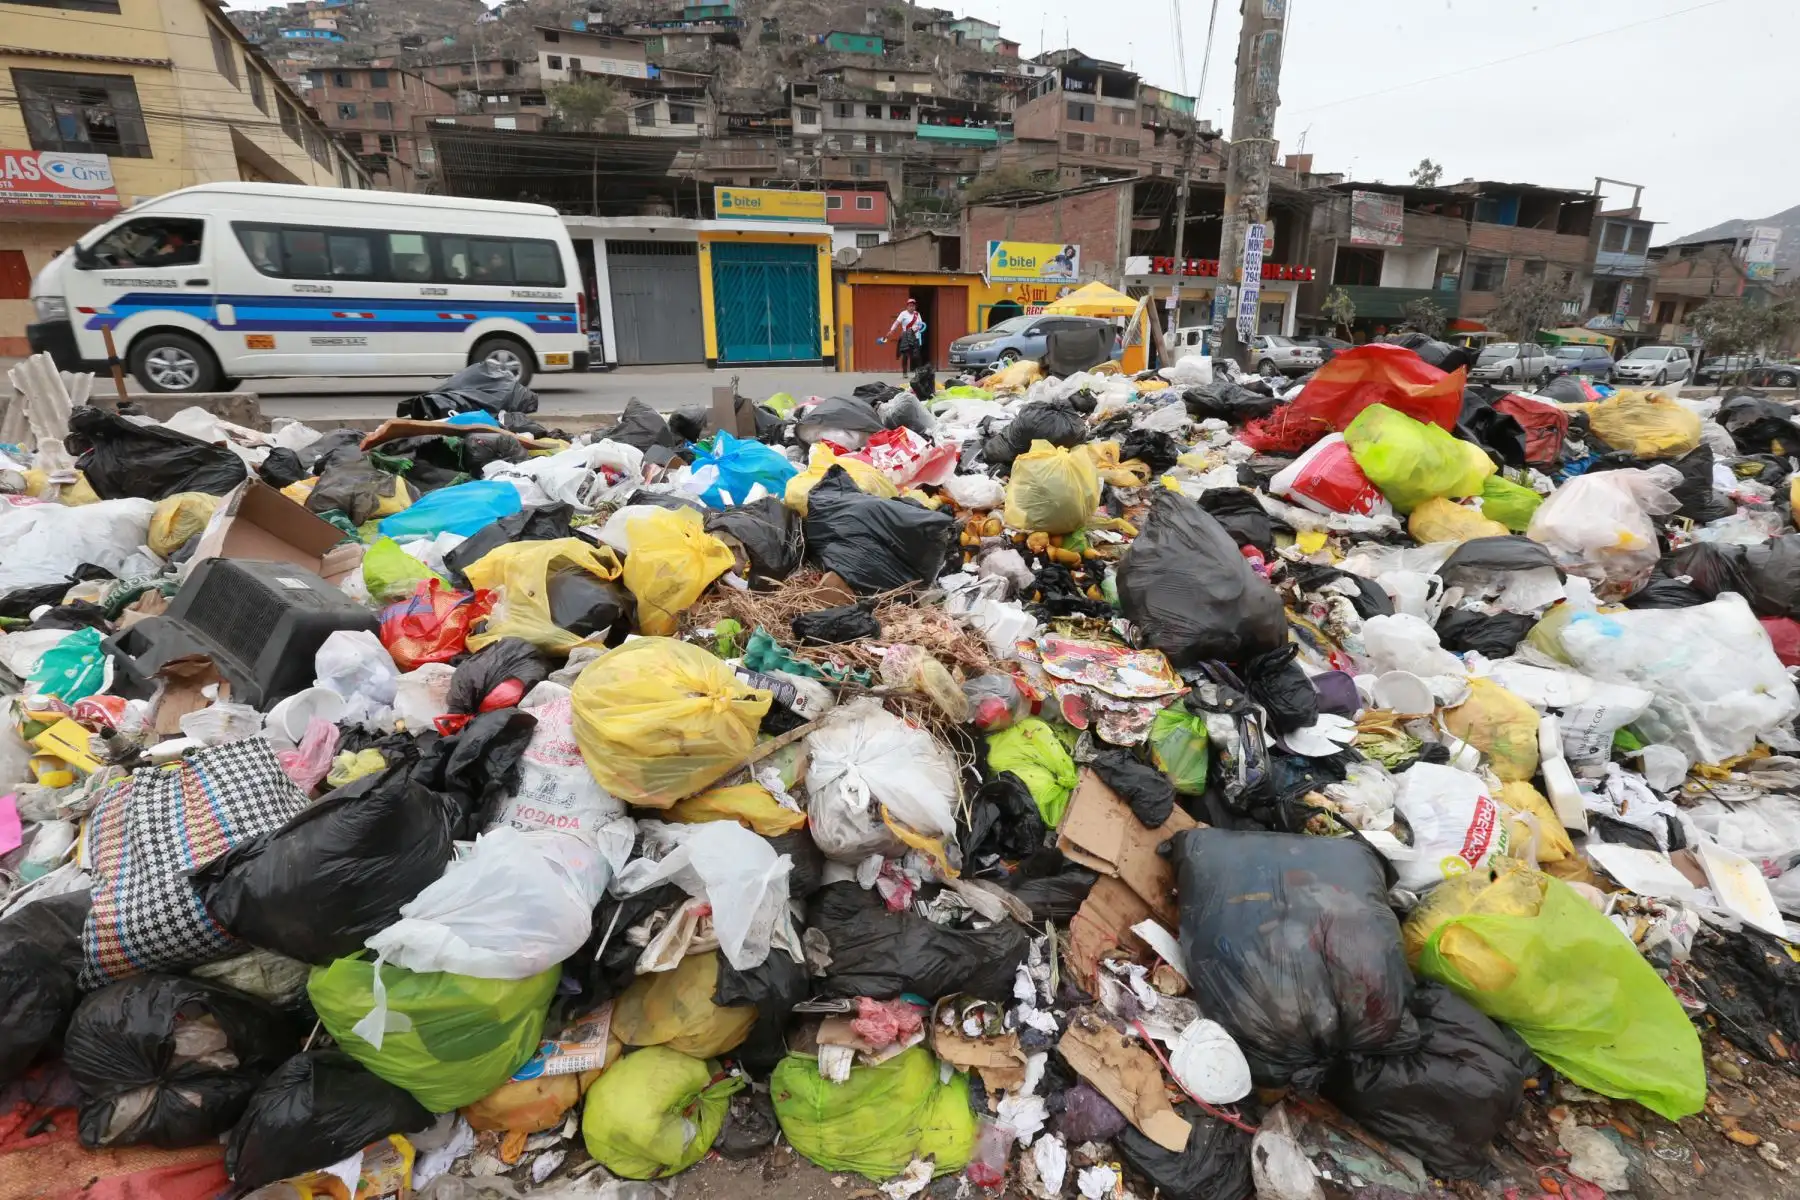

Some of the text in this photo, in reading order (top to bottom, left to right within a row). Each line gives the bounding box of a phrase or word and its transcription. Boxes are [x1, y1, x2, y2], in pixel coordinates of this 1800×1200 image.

[0, 155, 41, 181] AS
[734, 196, 761, 208] bitel
[1009, 255, 1036, 268] bitel
[515, 804, 581, 830] YODADA
